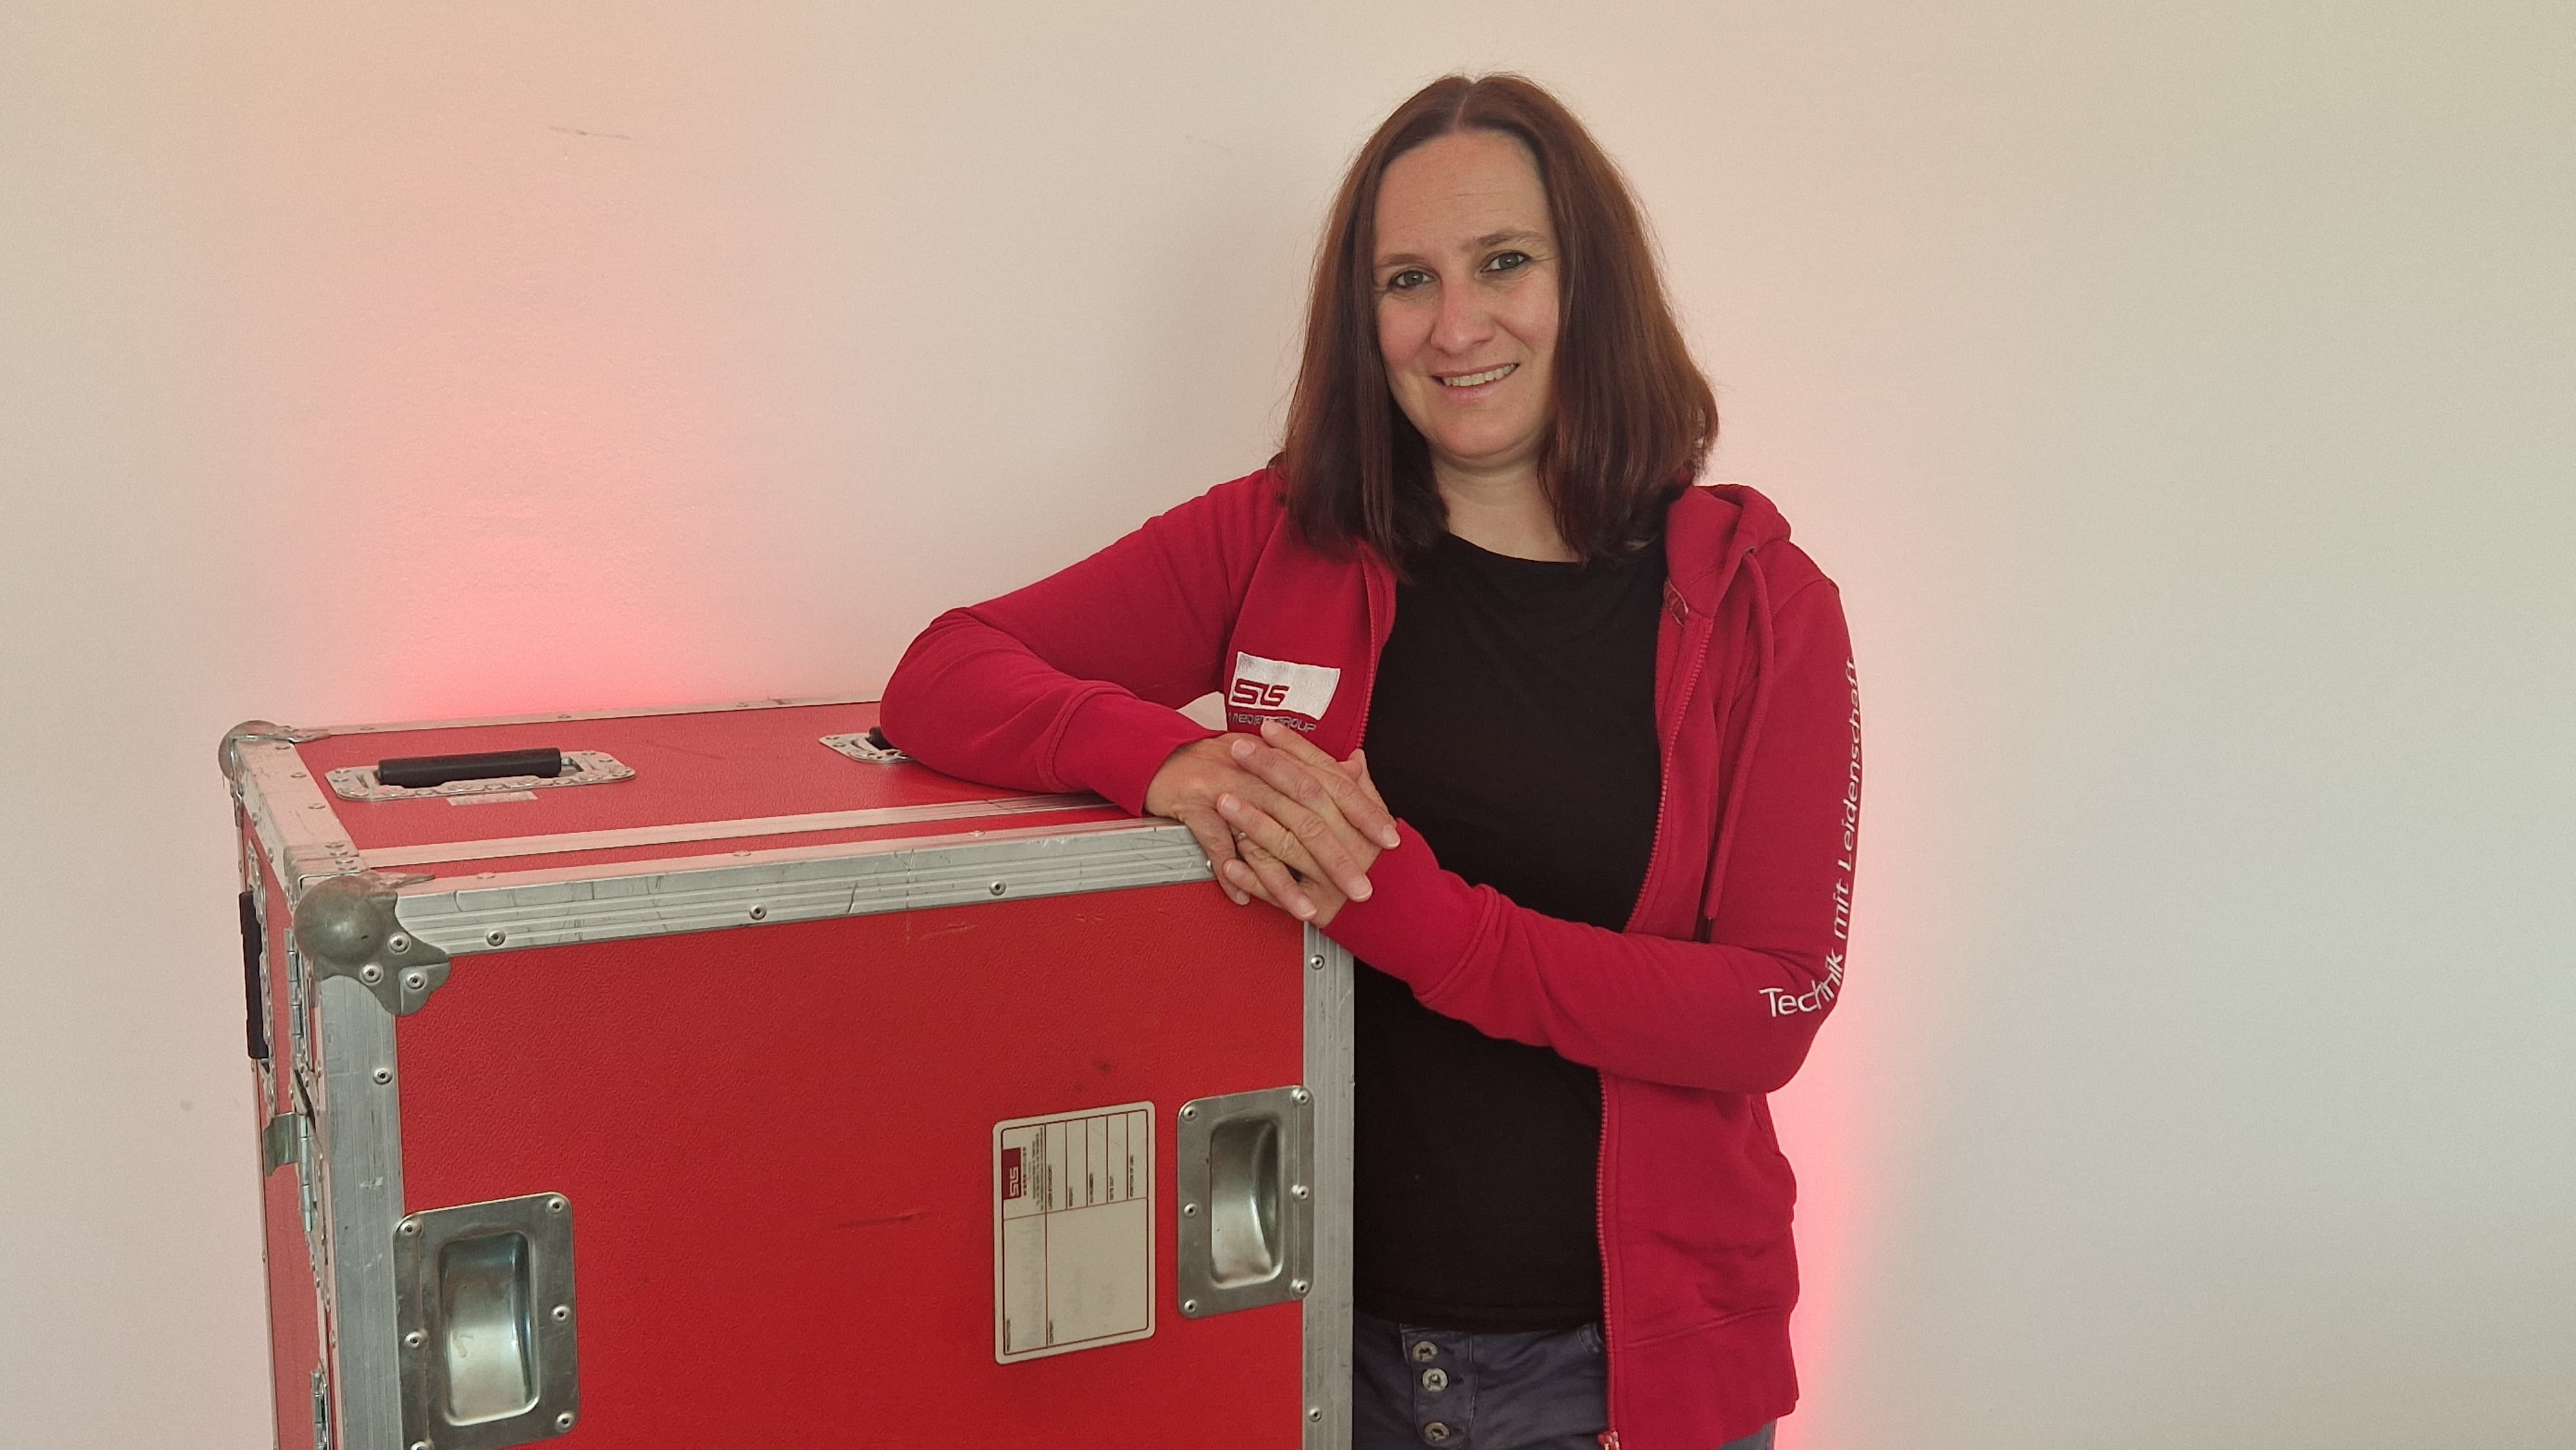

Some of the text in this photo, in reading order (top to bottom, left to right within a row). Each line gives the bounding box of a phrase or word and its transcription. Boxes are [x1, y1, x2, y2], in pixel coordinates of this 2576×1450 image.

[1759, 657, 1861, 1017] Technik mit Leidenschaft
